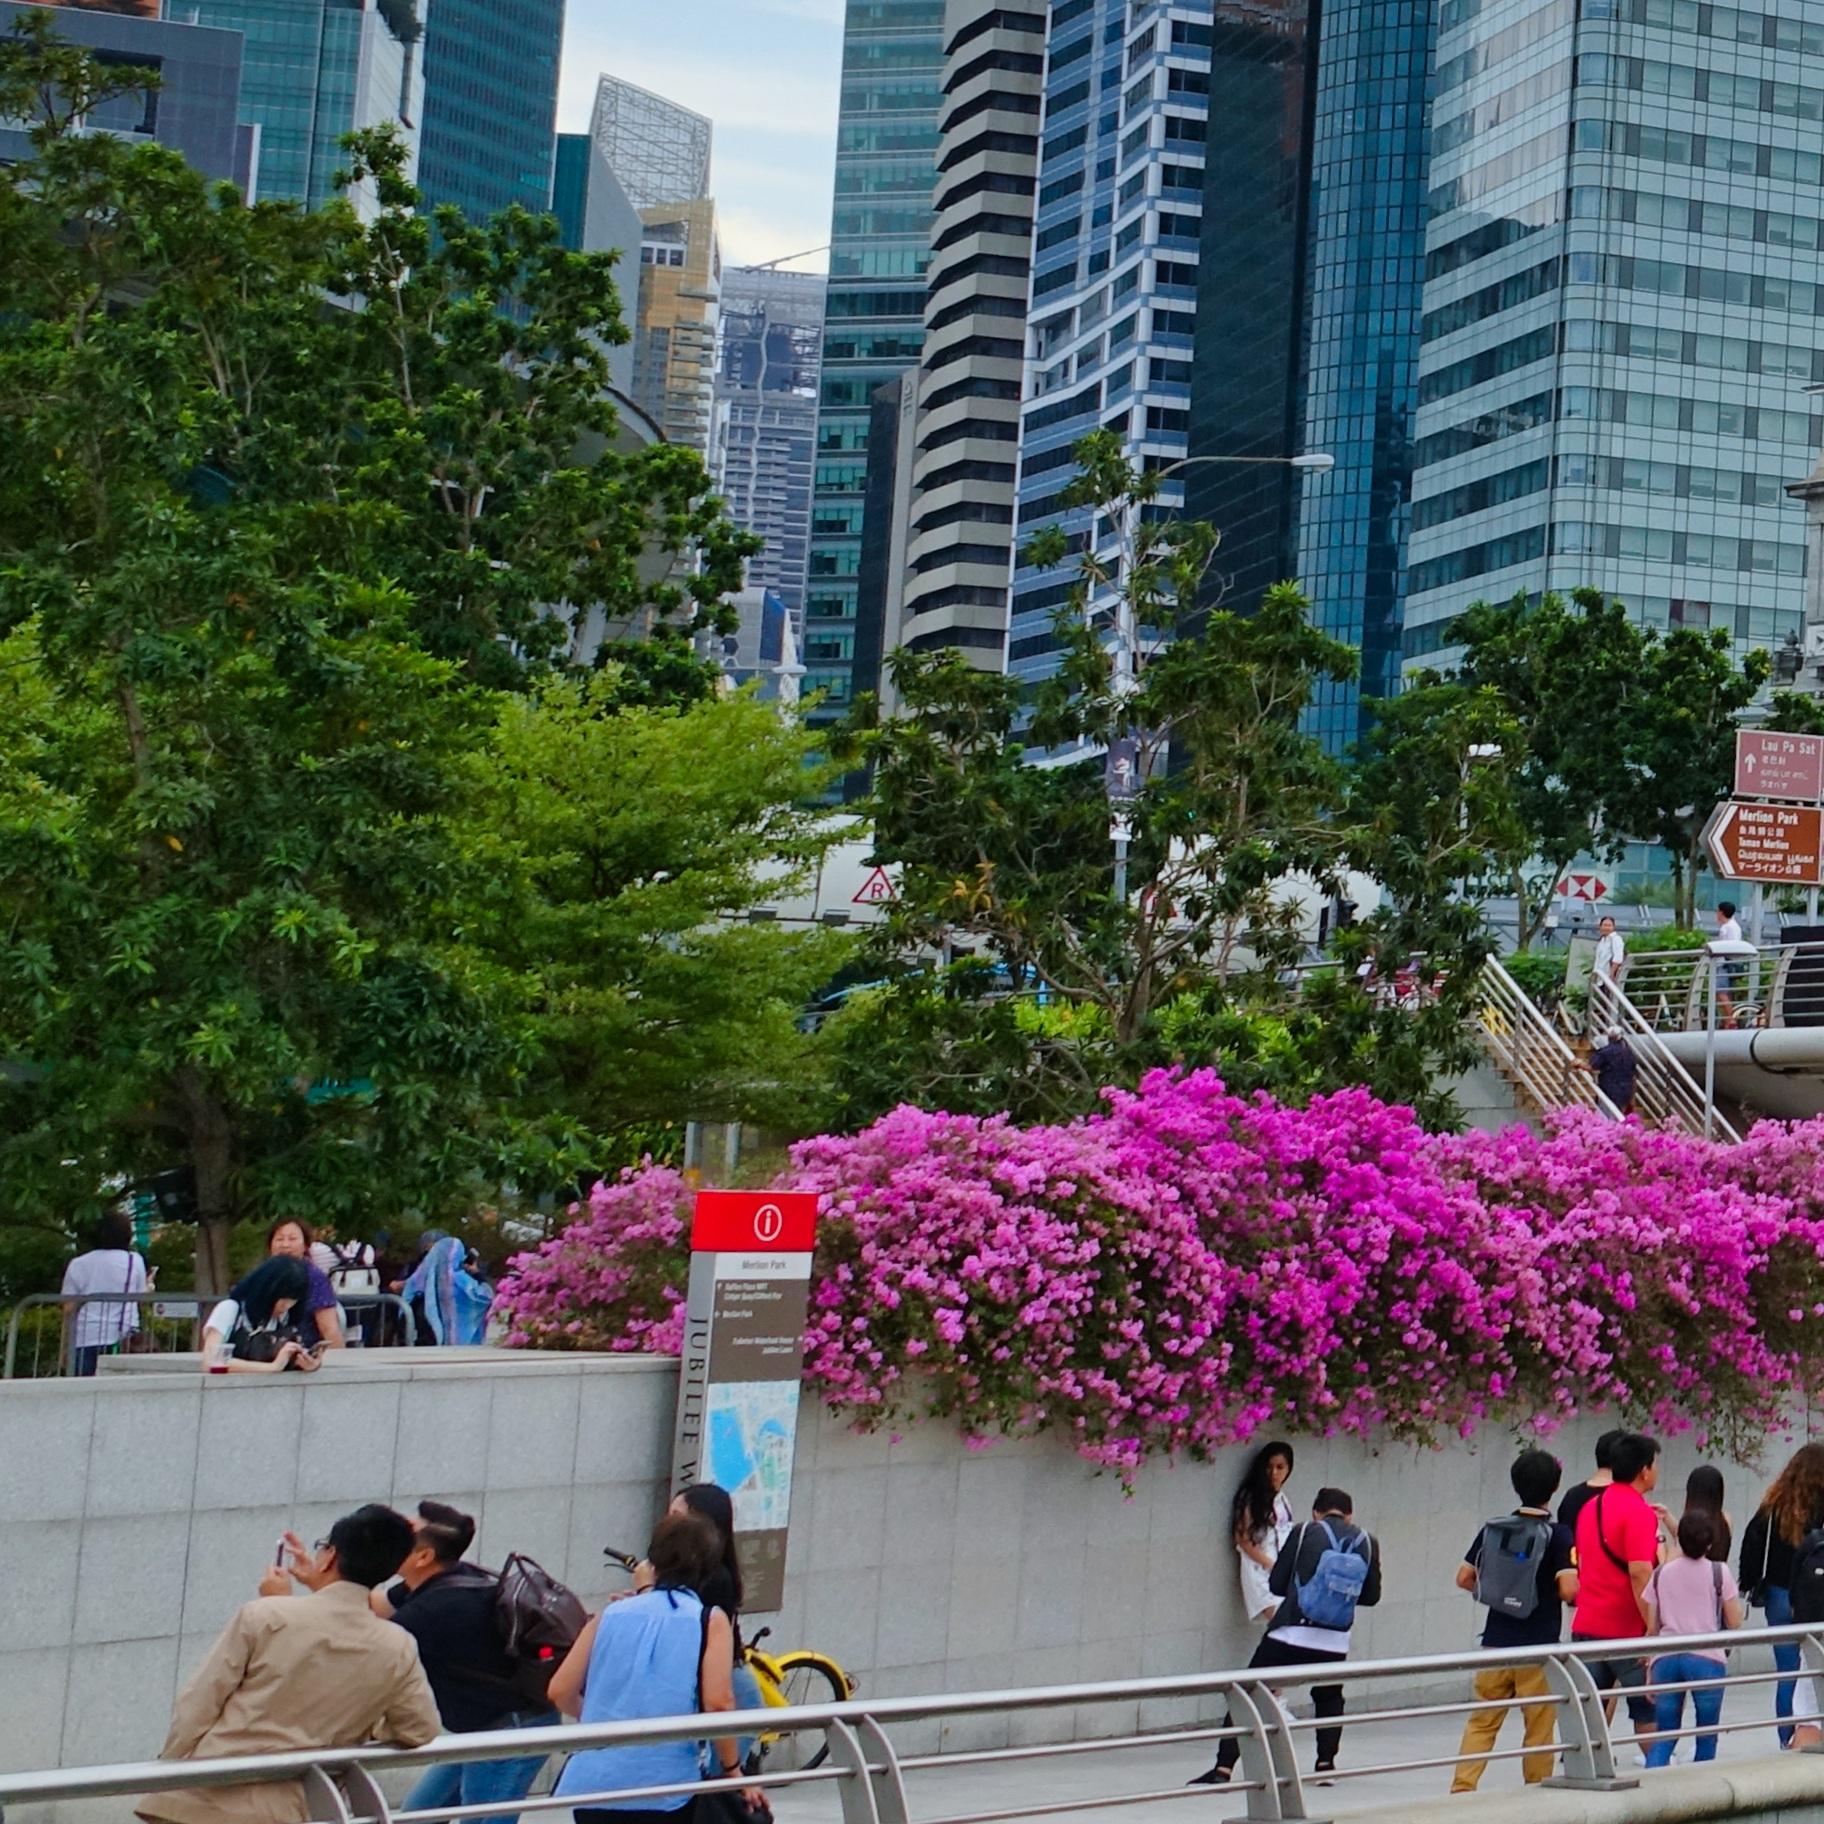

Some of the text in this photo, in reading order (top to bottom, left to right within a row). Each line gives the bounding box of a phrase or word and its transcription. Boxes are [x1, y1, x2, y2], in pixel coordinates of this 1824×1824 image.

[1761, 738, 1816, 756] Lau Pa Sat
[1738, 808, 1799, 826] Merlion Park
[681, 1317, 708, 1445] JUBILEE
